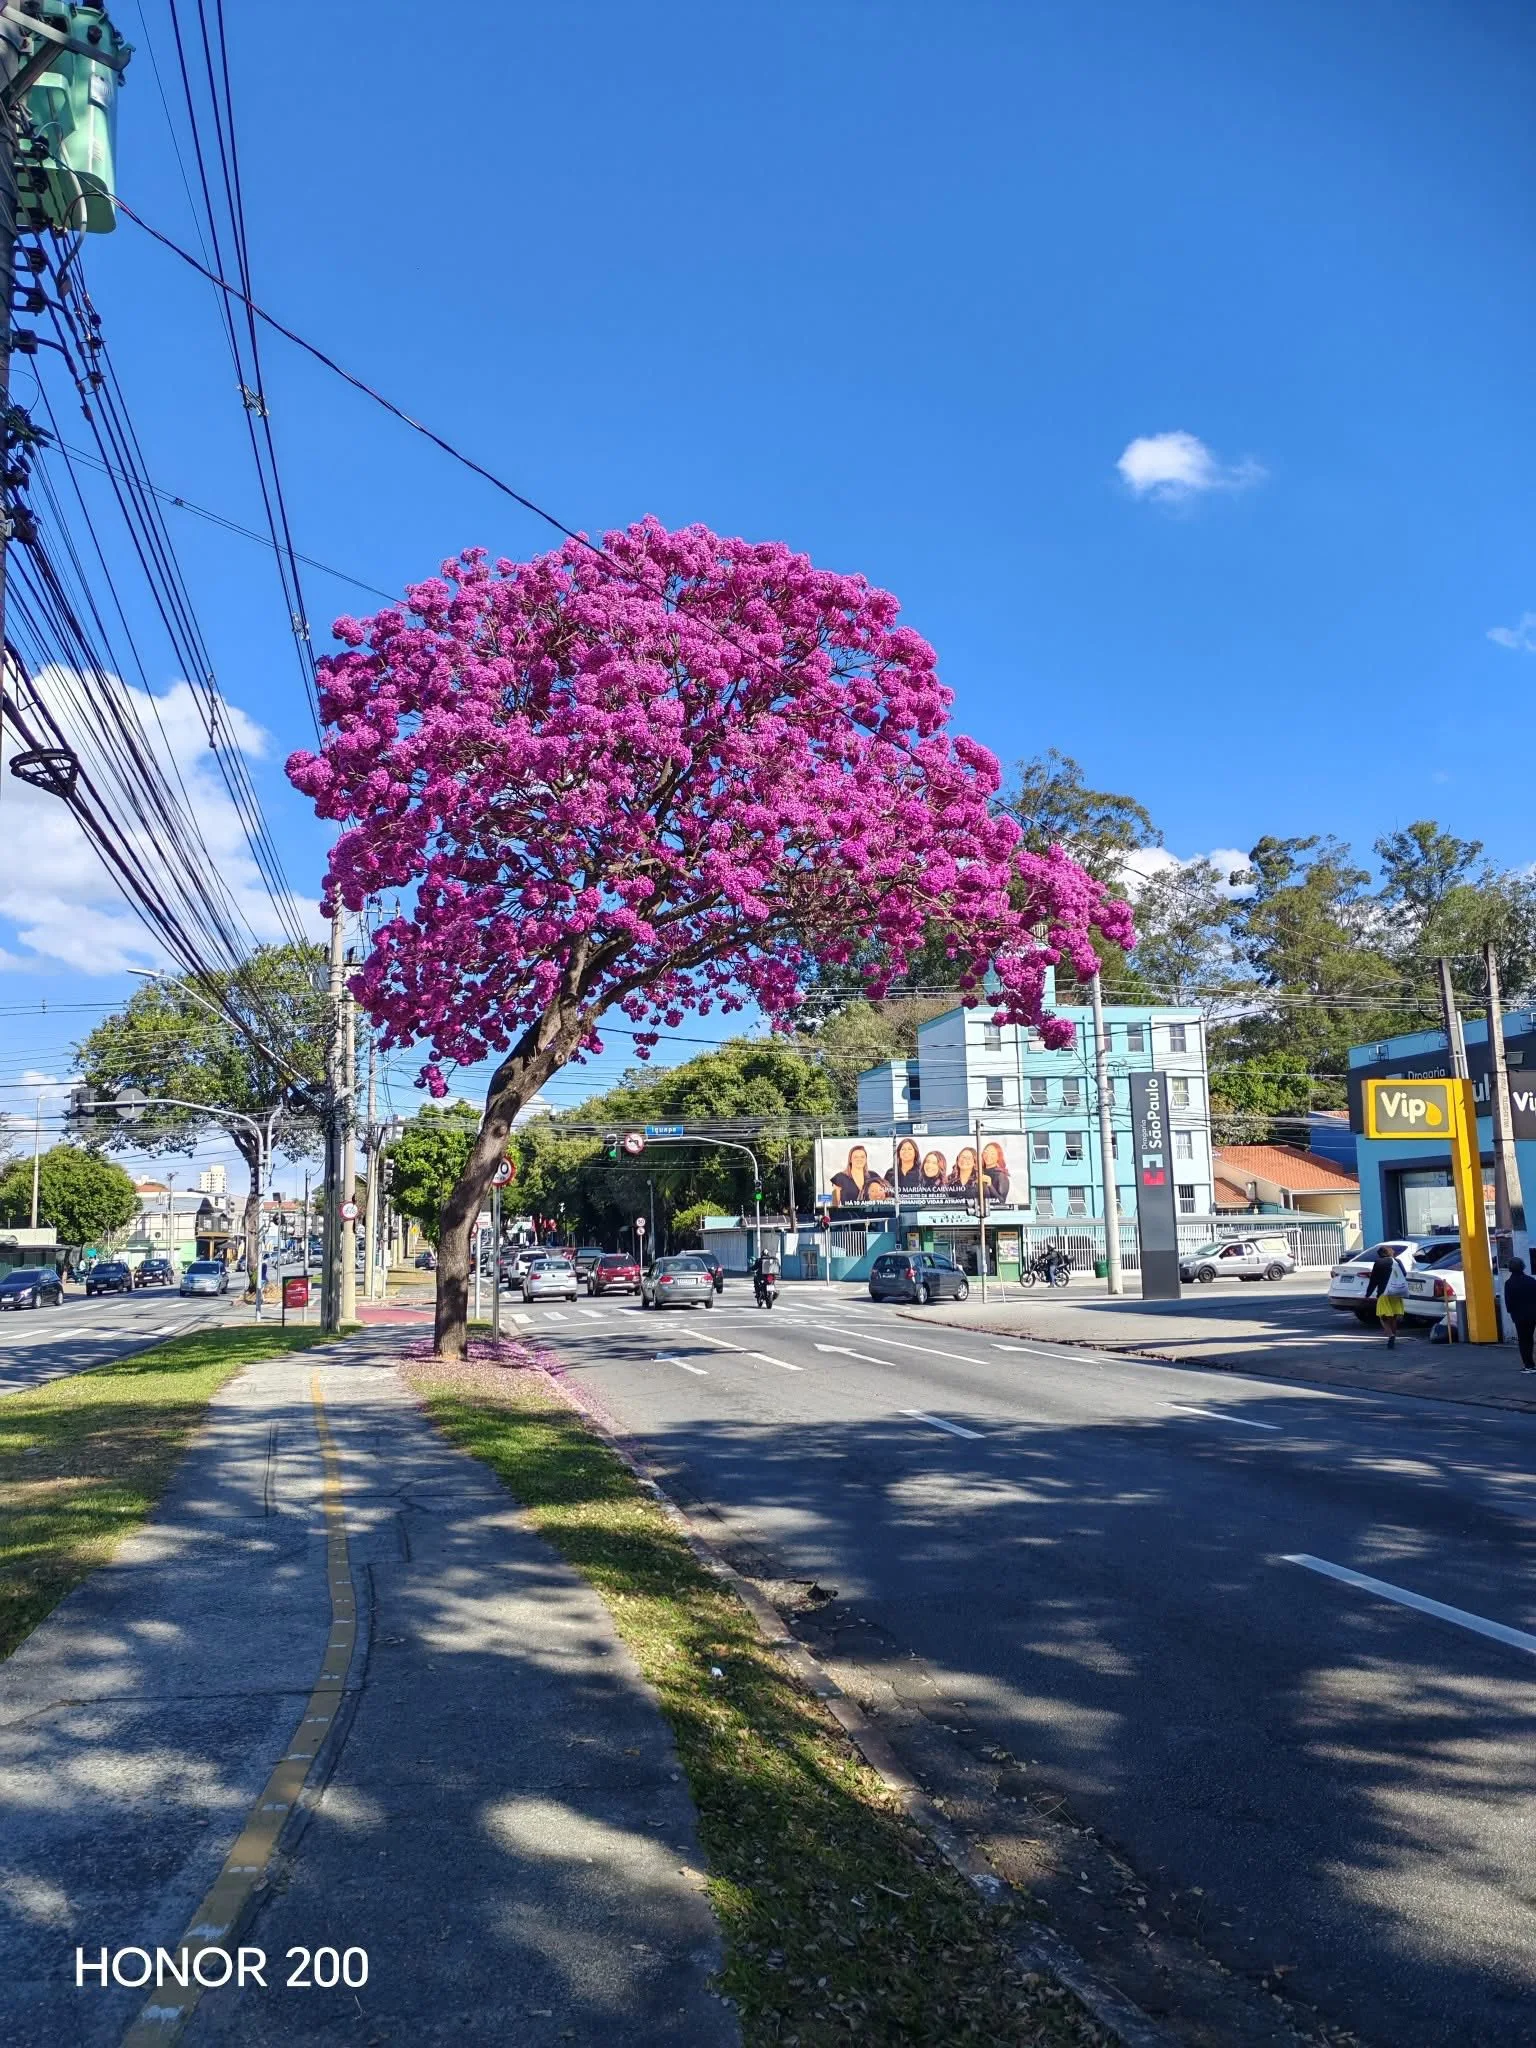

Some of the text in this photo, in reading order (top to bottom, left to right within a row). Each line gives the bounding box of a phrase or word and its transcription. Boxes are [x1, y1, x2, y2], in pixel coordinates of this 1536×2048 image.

[1408, 1066, 1446, 1080] Drogaria
[1145, 1078, 1163, 1149] SãoPaulo
[1380, 1091, 1426, 1124] Vip
[500, 1161, 510, 1175] 0
